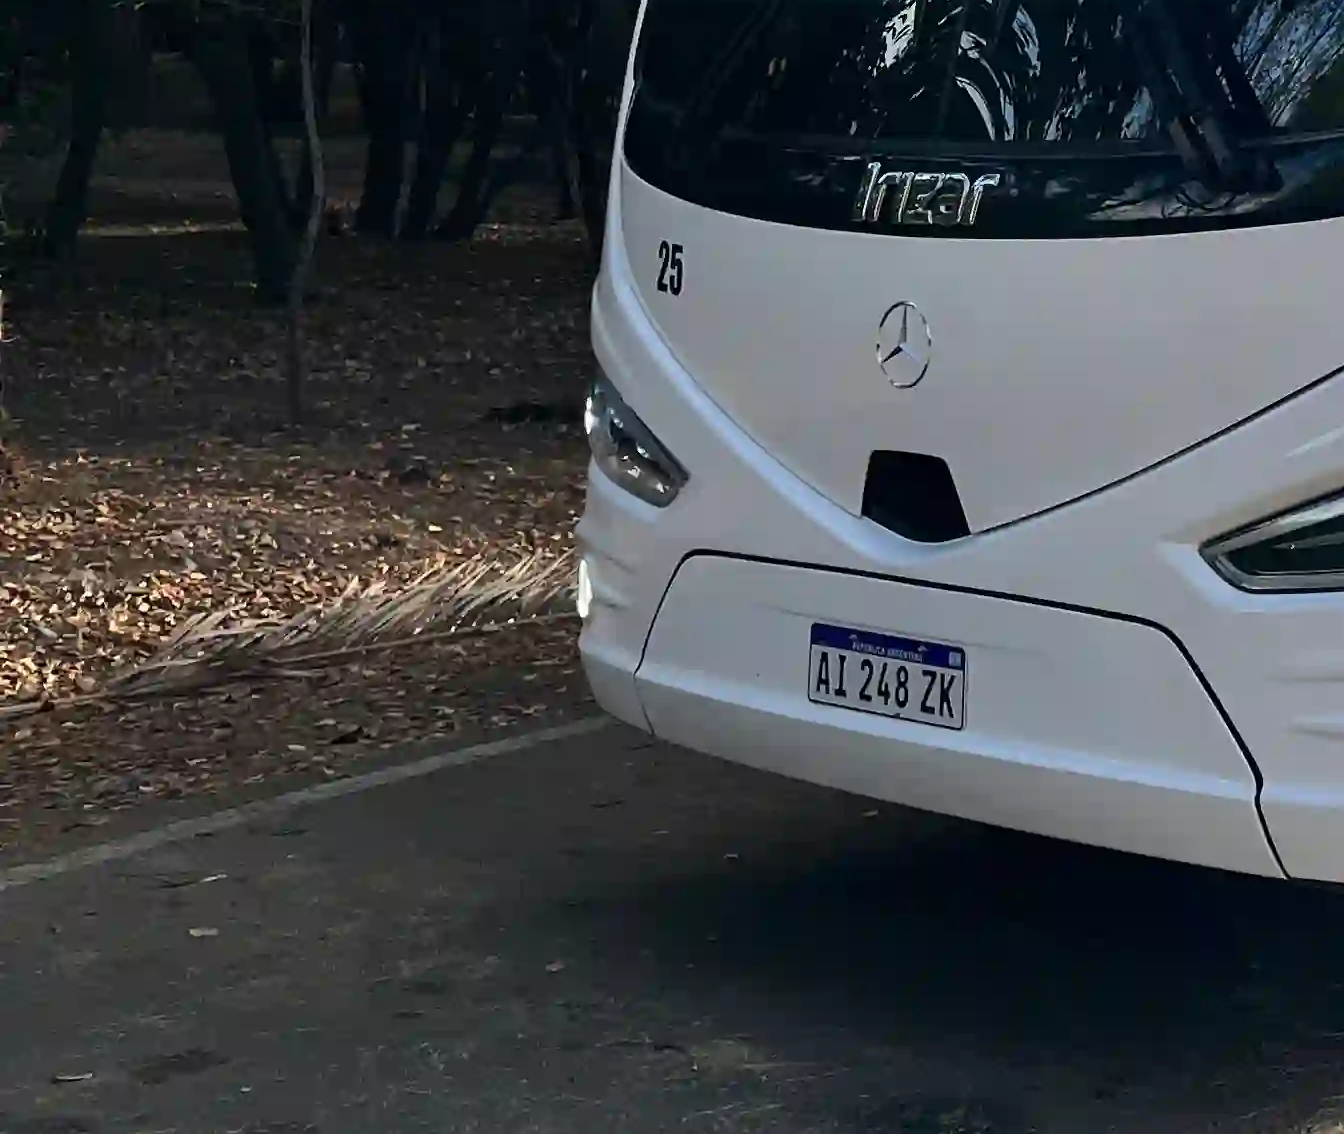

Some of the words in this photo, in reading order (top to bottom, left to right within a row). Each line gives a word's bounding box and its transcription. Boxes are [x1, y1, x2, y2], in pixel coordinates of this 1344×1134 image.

[854, 161, 1000, 225] Irizar
[657, 239, 684, 297] 25
[815, 651, 847, 698] AI
[859, 658, 909, 709] 248
[920, 669, 957, 719] ZK
